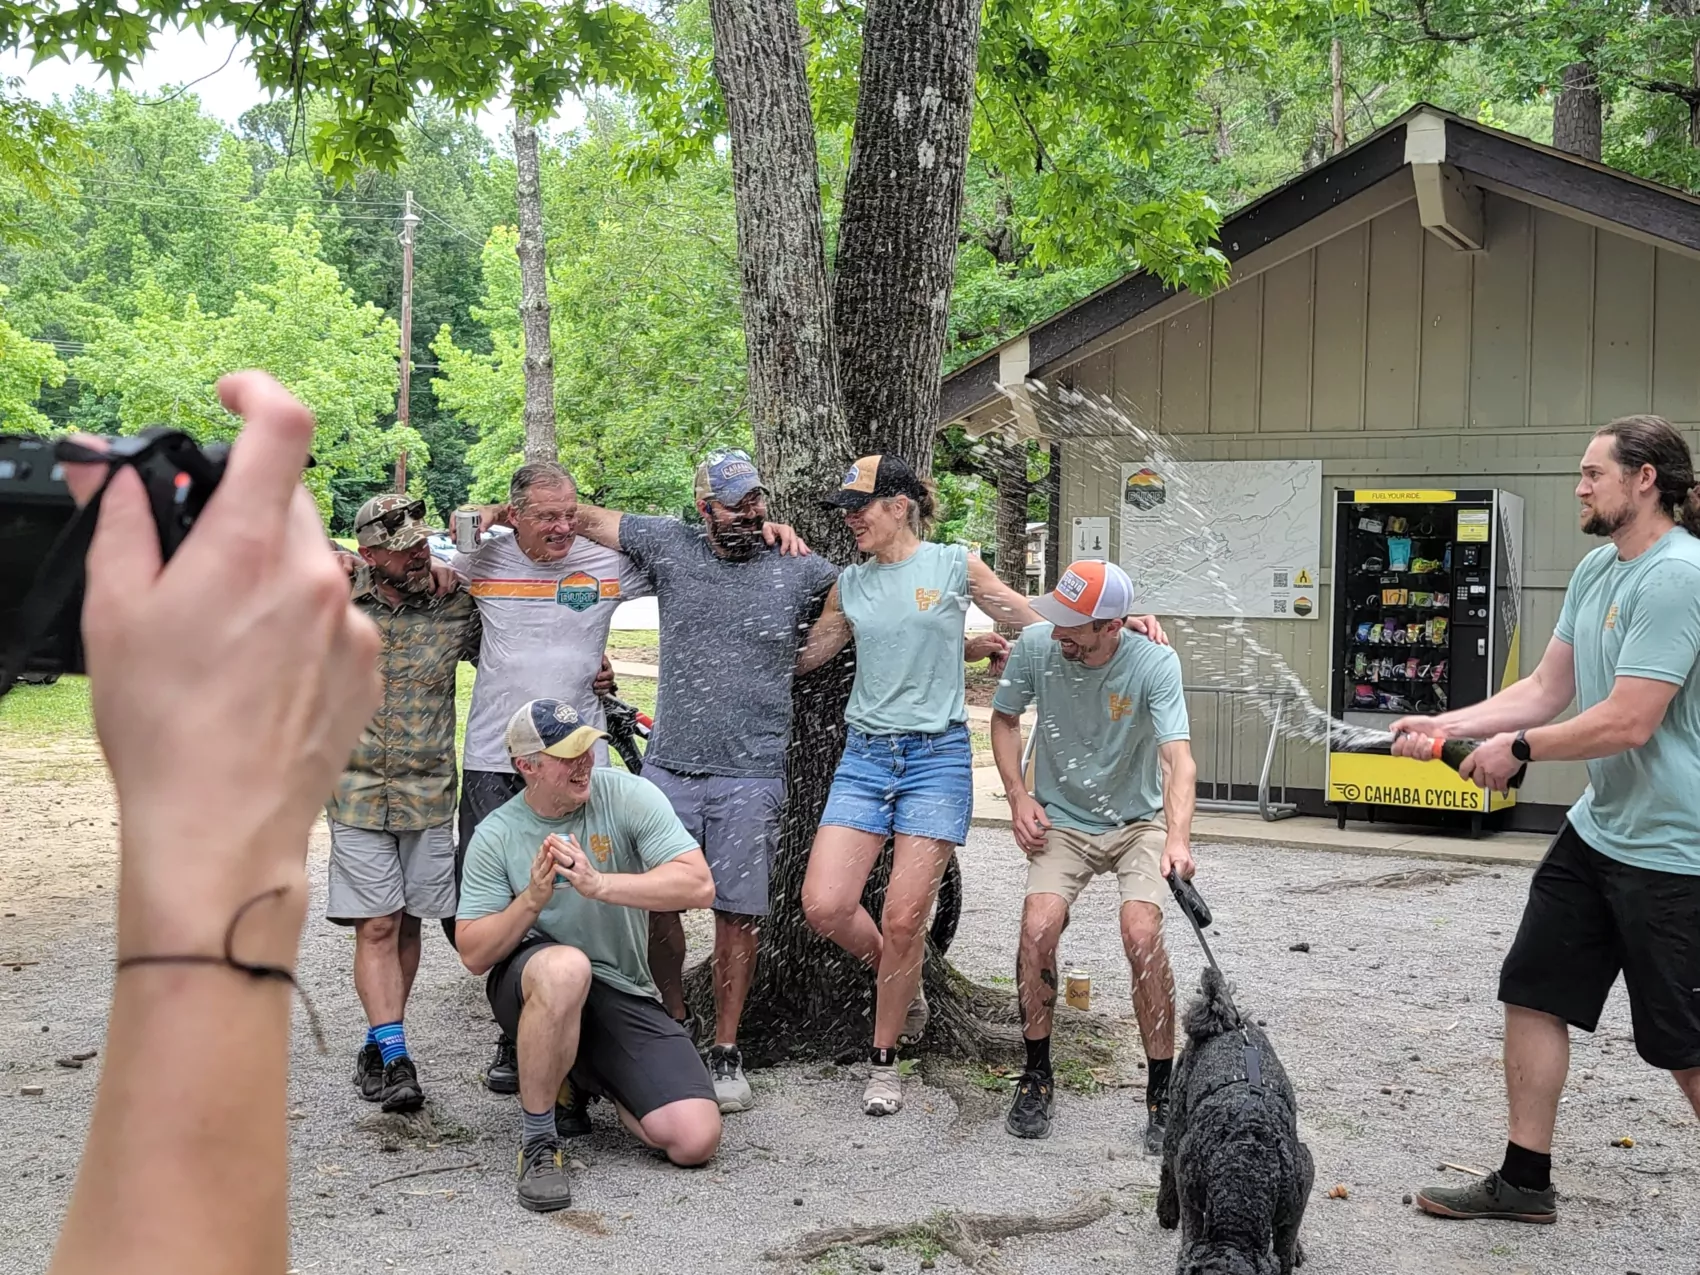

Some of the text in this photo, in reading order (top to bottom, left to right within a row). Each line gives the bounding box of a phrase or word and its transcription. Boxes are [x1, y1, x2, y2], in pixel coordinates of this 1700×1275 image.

[561, 592, 597, 603] BUMP
[1364, 785, 1421, 805] CAHABA
[1425, 789, 1479, 809] CYCLES
